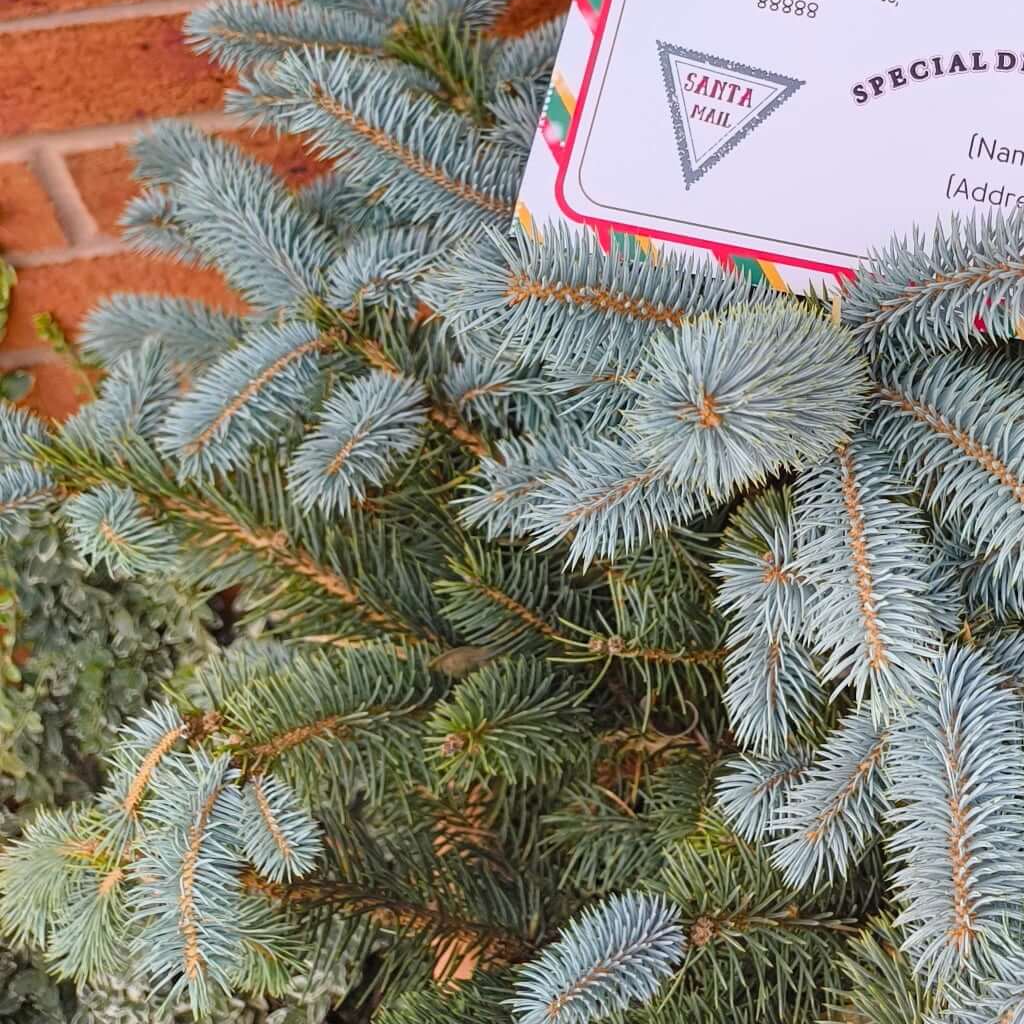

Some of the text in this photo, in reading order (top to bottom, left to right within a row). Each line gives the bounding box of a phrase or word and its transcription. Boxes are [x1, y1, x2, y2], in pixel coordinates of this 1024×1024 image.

[684, 72, 753, 108] SANTA
[852, 51, 988, 104] SPECIAL
[690, 104, 732, 129] MAIL
